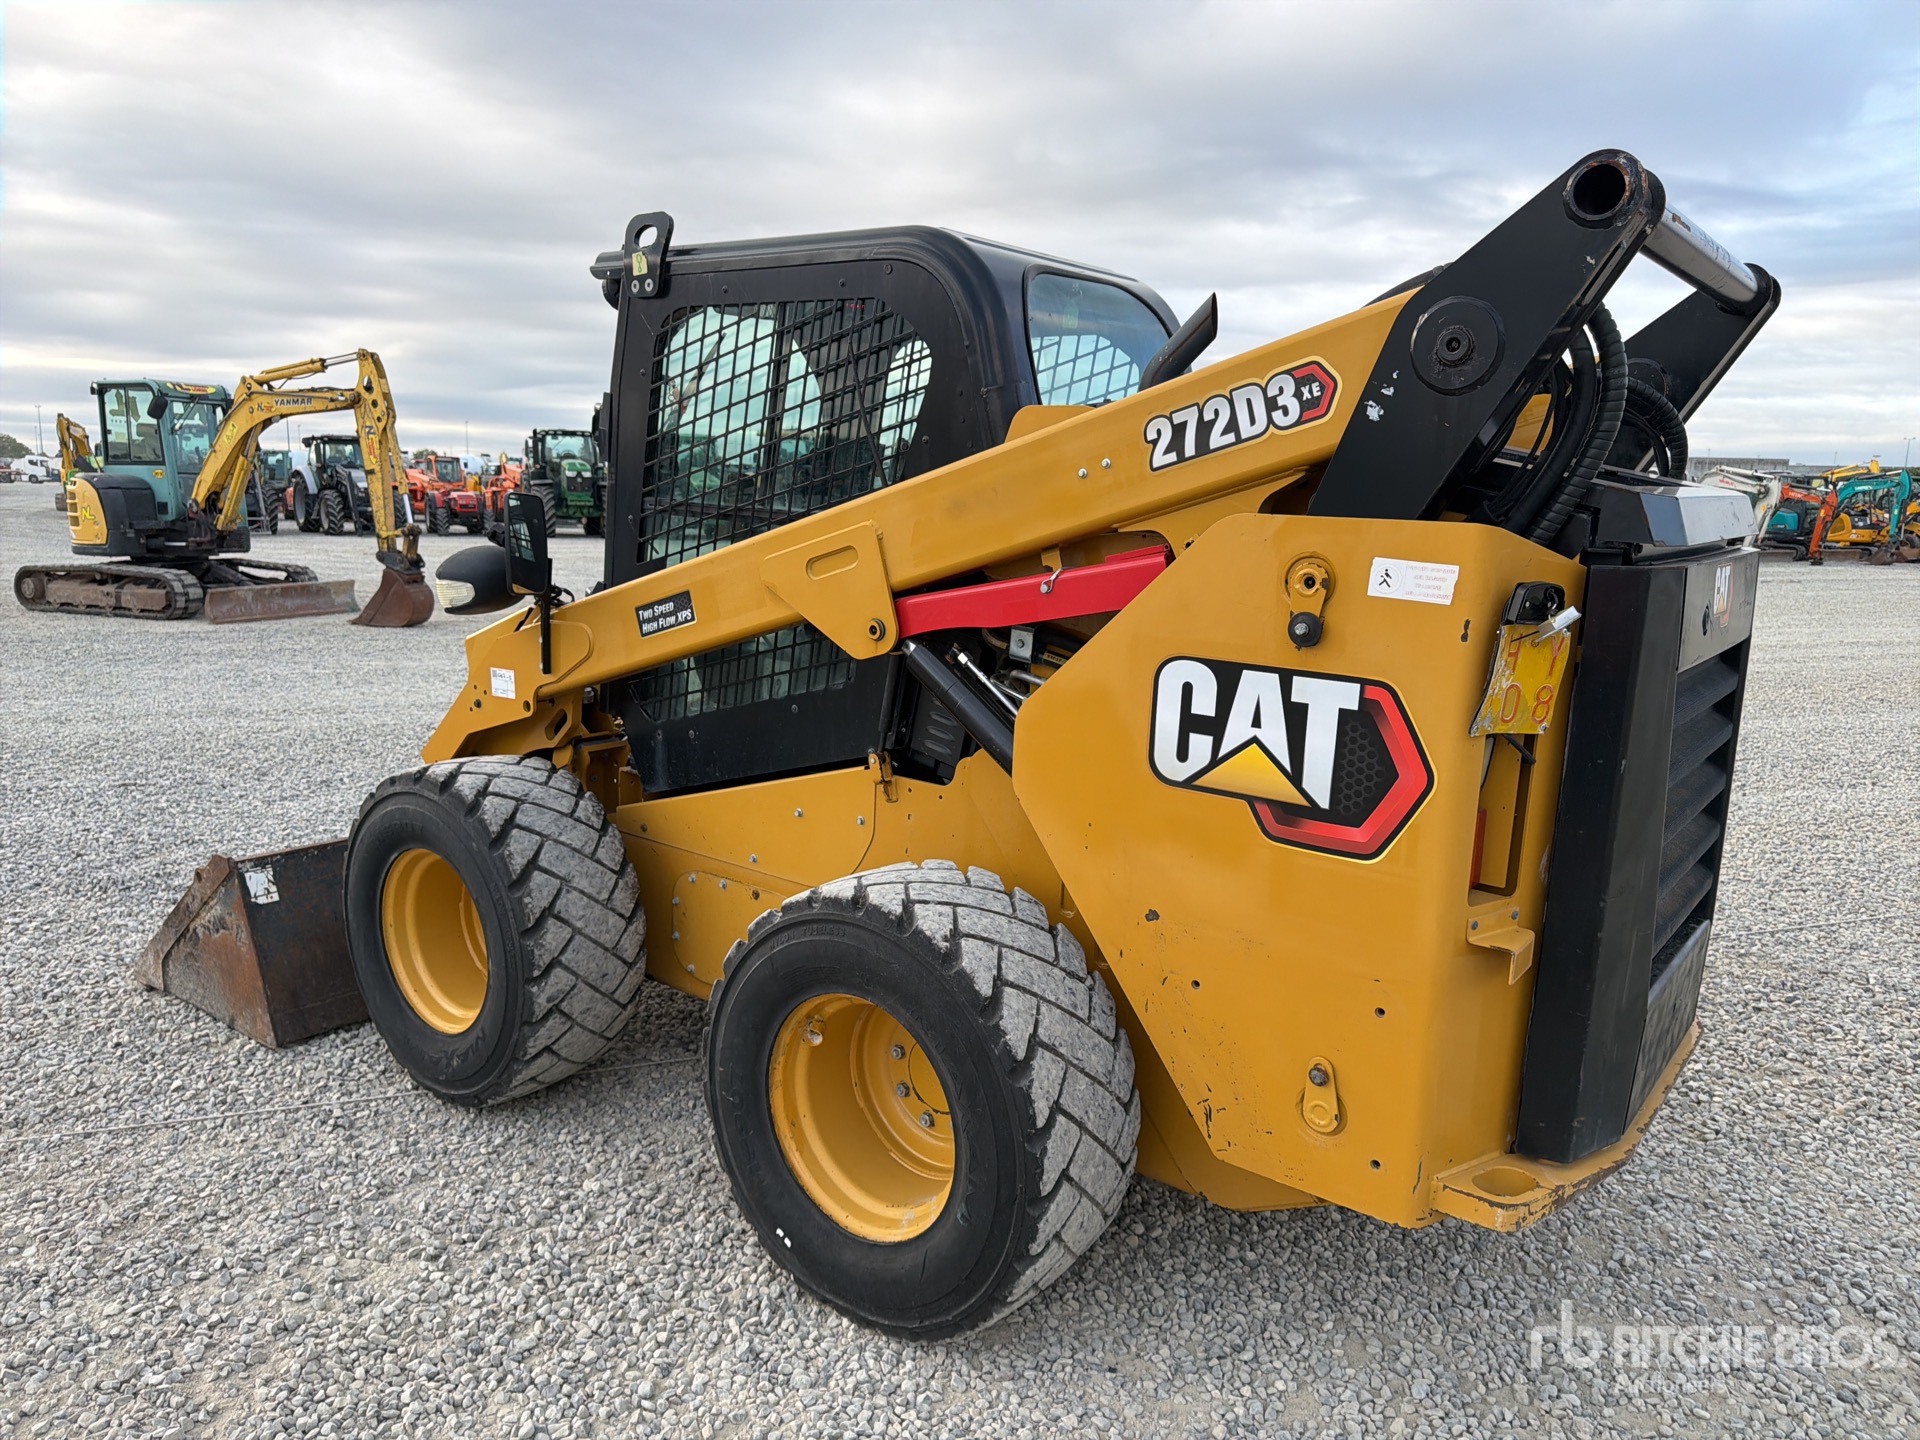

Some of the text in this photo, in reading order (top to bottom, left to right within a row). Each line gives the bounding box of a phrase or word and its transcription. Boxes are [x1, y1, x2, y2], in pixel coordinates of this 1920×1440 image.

[274, 397, 313, 407] YANMAR
[1146, 374, 1322, 469] 272D3 XE
[677, 608, 692, 622] XPS
[1154, 659, 1362, 811] CAT
